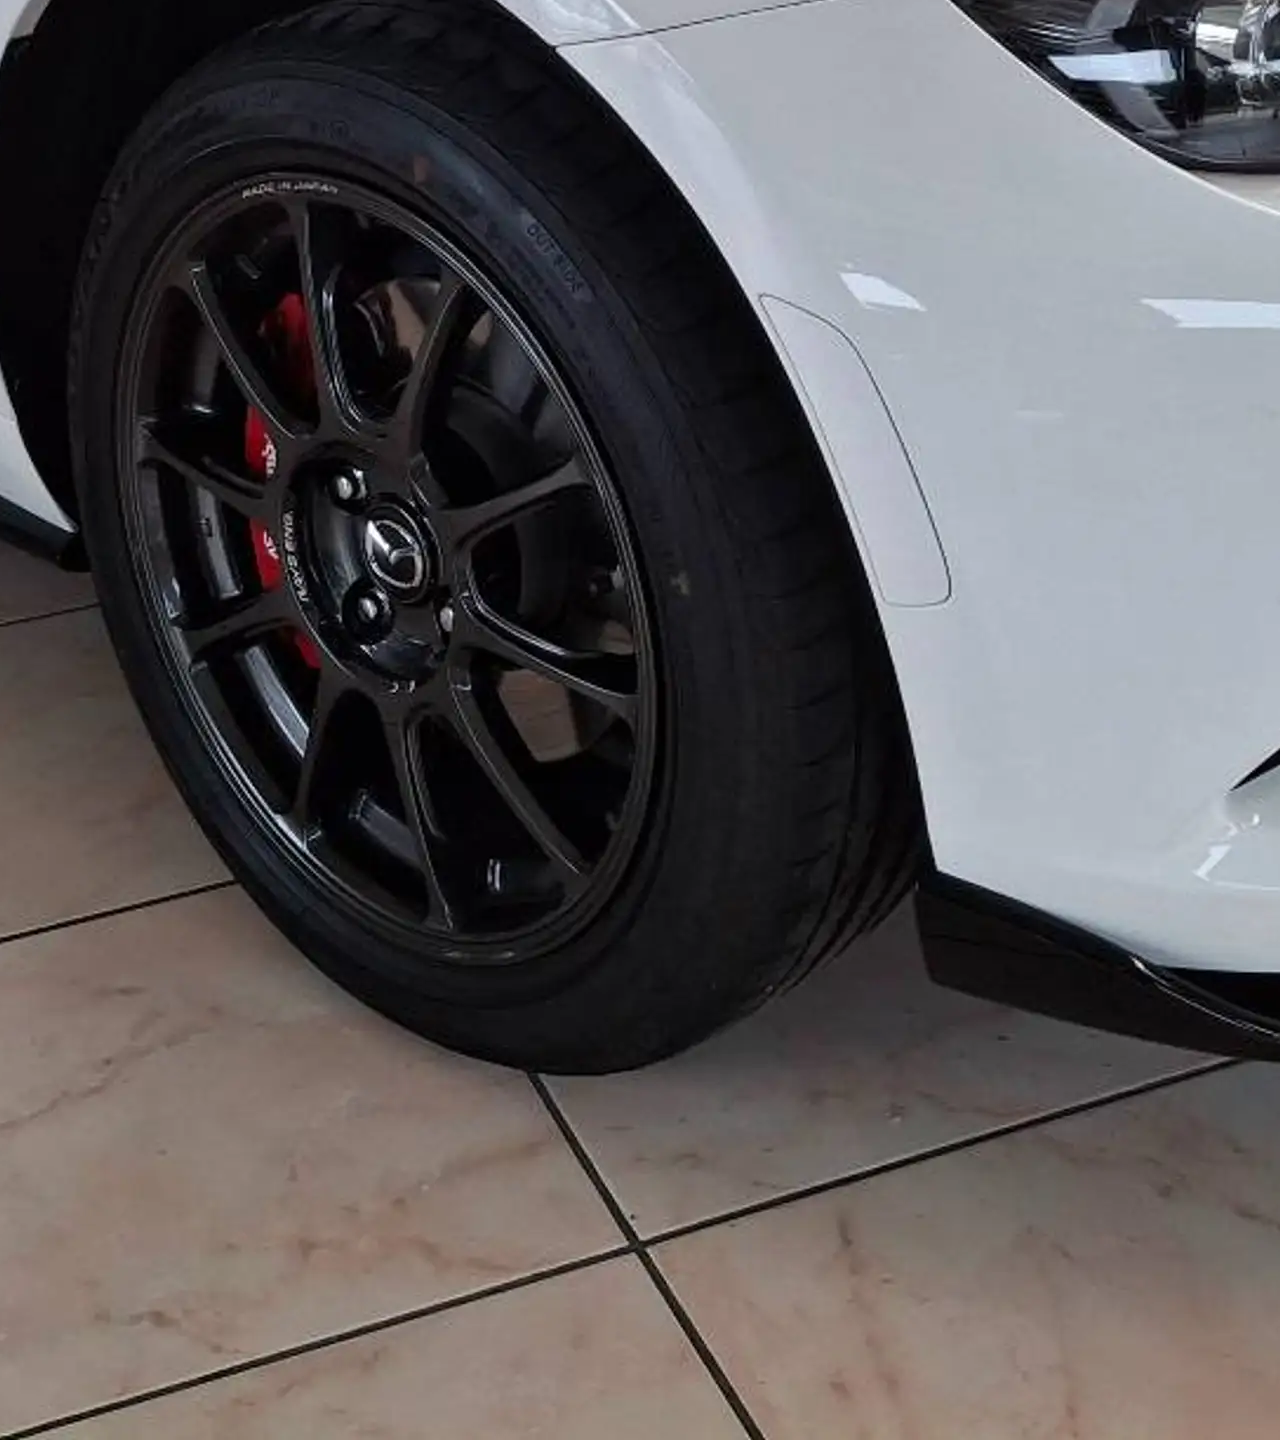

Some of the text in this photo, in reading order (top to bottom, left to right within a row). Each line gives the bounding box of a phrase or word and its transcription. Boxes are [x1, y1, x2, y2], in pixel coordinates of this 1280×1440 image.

[241, 180, 339, 199] MADE IN JAPAN
